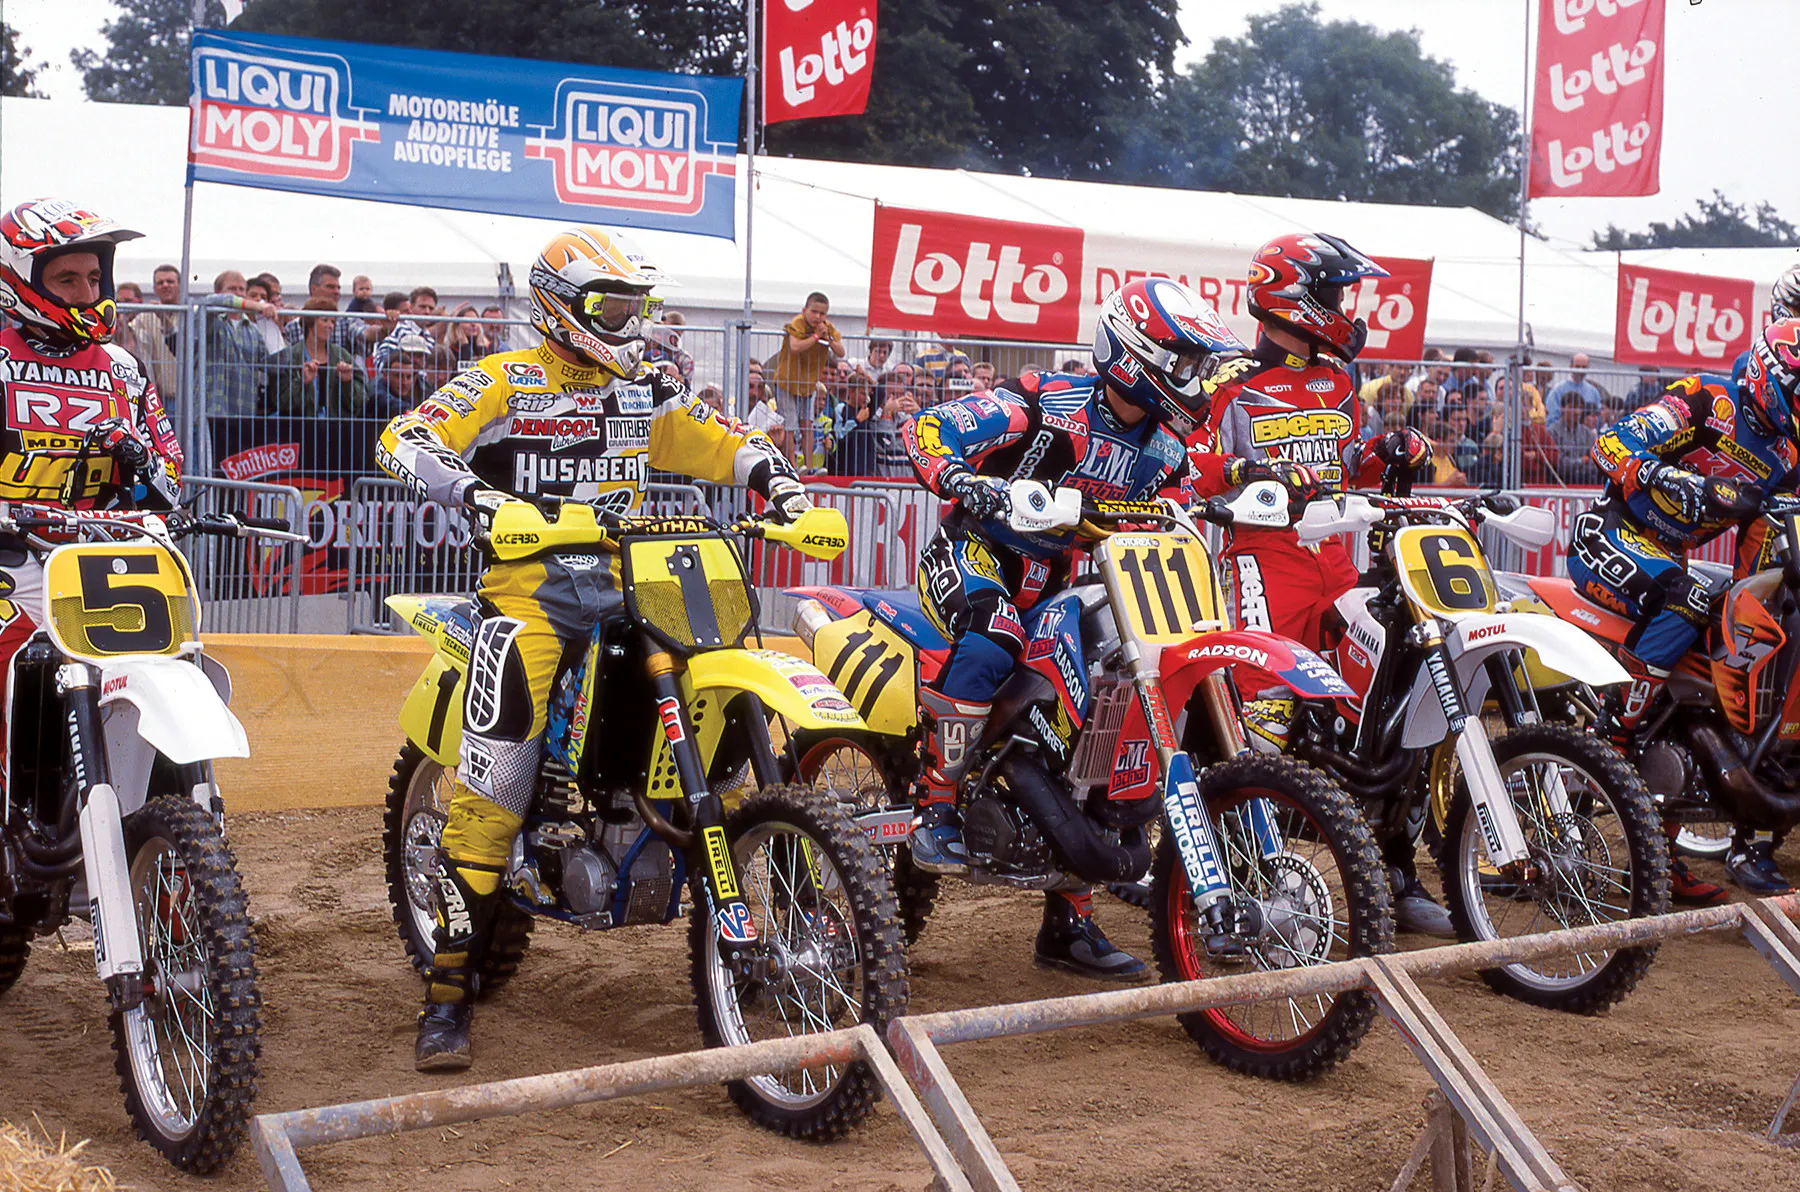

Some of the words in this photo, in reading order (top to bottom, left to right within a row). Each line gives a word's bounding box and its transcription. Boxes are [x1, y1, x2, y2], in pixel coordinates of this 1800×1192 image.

[205, 57, 326, 112] LIQUI
[779, 20, 875, 107] Lotto
[1549, 38, 1657, 112] Lotto
[203, 105, 329, 158] MOLY
[388, 93, 520, 128] MOTORENÖLE
[578, 103, 686, 149] LIQUI
[407, 120, 500, 148] ADDITIVE
[1548, 118, 1651, 188] Lotto
[393, 140, 513, 172] AUTOPFLEGE
[577, 144, 689, 192] MOLY
[890, 223, 1069, 326] Lotto
[1627, 277, 1744, 358] Lotto
[571, 333, 613, 362] CERTINA
[8, 360, 114, 392] YAMAHA
[14, 389, 103, 432] RZ
[507, 397, 554, 412] GRIP
[576, 395, 597, 407] W
[509, 418, 599, 437] DENICOL
[227, 450, 279, 481] Smiths
[1680, 446, 1758, 483] KT
[494, 534, 540, 545] ACERBIS
[618, 518, 709, 532] RENTHAL
[801, 534, 846, 548] ACERBIS
[1119, 547, 1205, 636] 111
[1419, 533, 1489, 611] 6
[77, 554, 174, 654] 5
[665, 544, 723, 647] 1
[1584, 580, 1630, 616] KTM
[443, 616, 473, 648] Husabe
[1353, 622, 1381, 656] YAMAHA
[1467, 623, 1506, 642] MOTUL
[1569, 608, 1601, 627] KTM
[827, 629, 905, 724] 111
[1055, 642, 1086, 710] RADSON
[1186, 644, 1269, 667] RADSON
[103, 675, 129, 696] MOTUL
[1425, 650, 1461, 719] YAMAHA
[426, 665, 462, 755] 1
[1145, 685, 1177, 749] SHOWA
[1029, 704, 1066, 762] MOTOREX
[707, 827, 737, 895] PIRELLI
[1163, 793, 1208, 894] MOTOREX
[718, 902, 750, 941] VP
